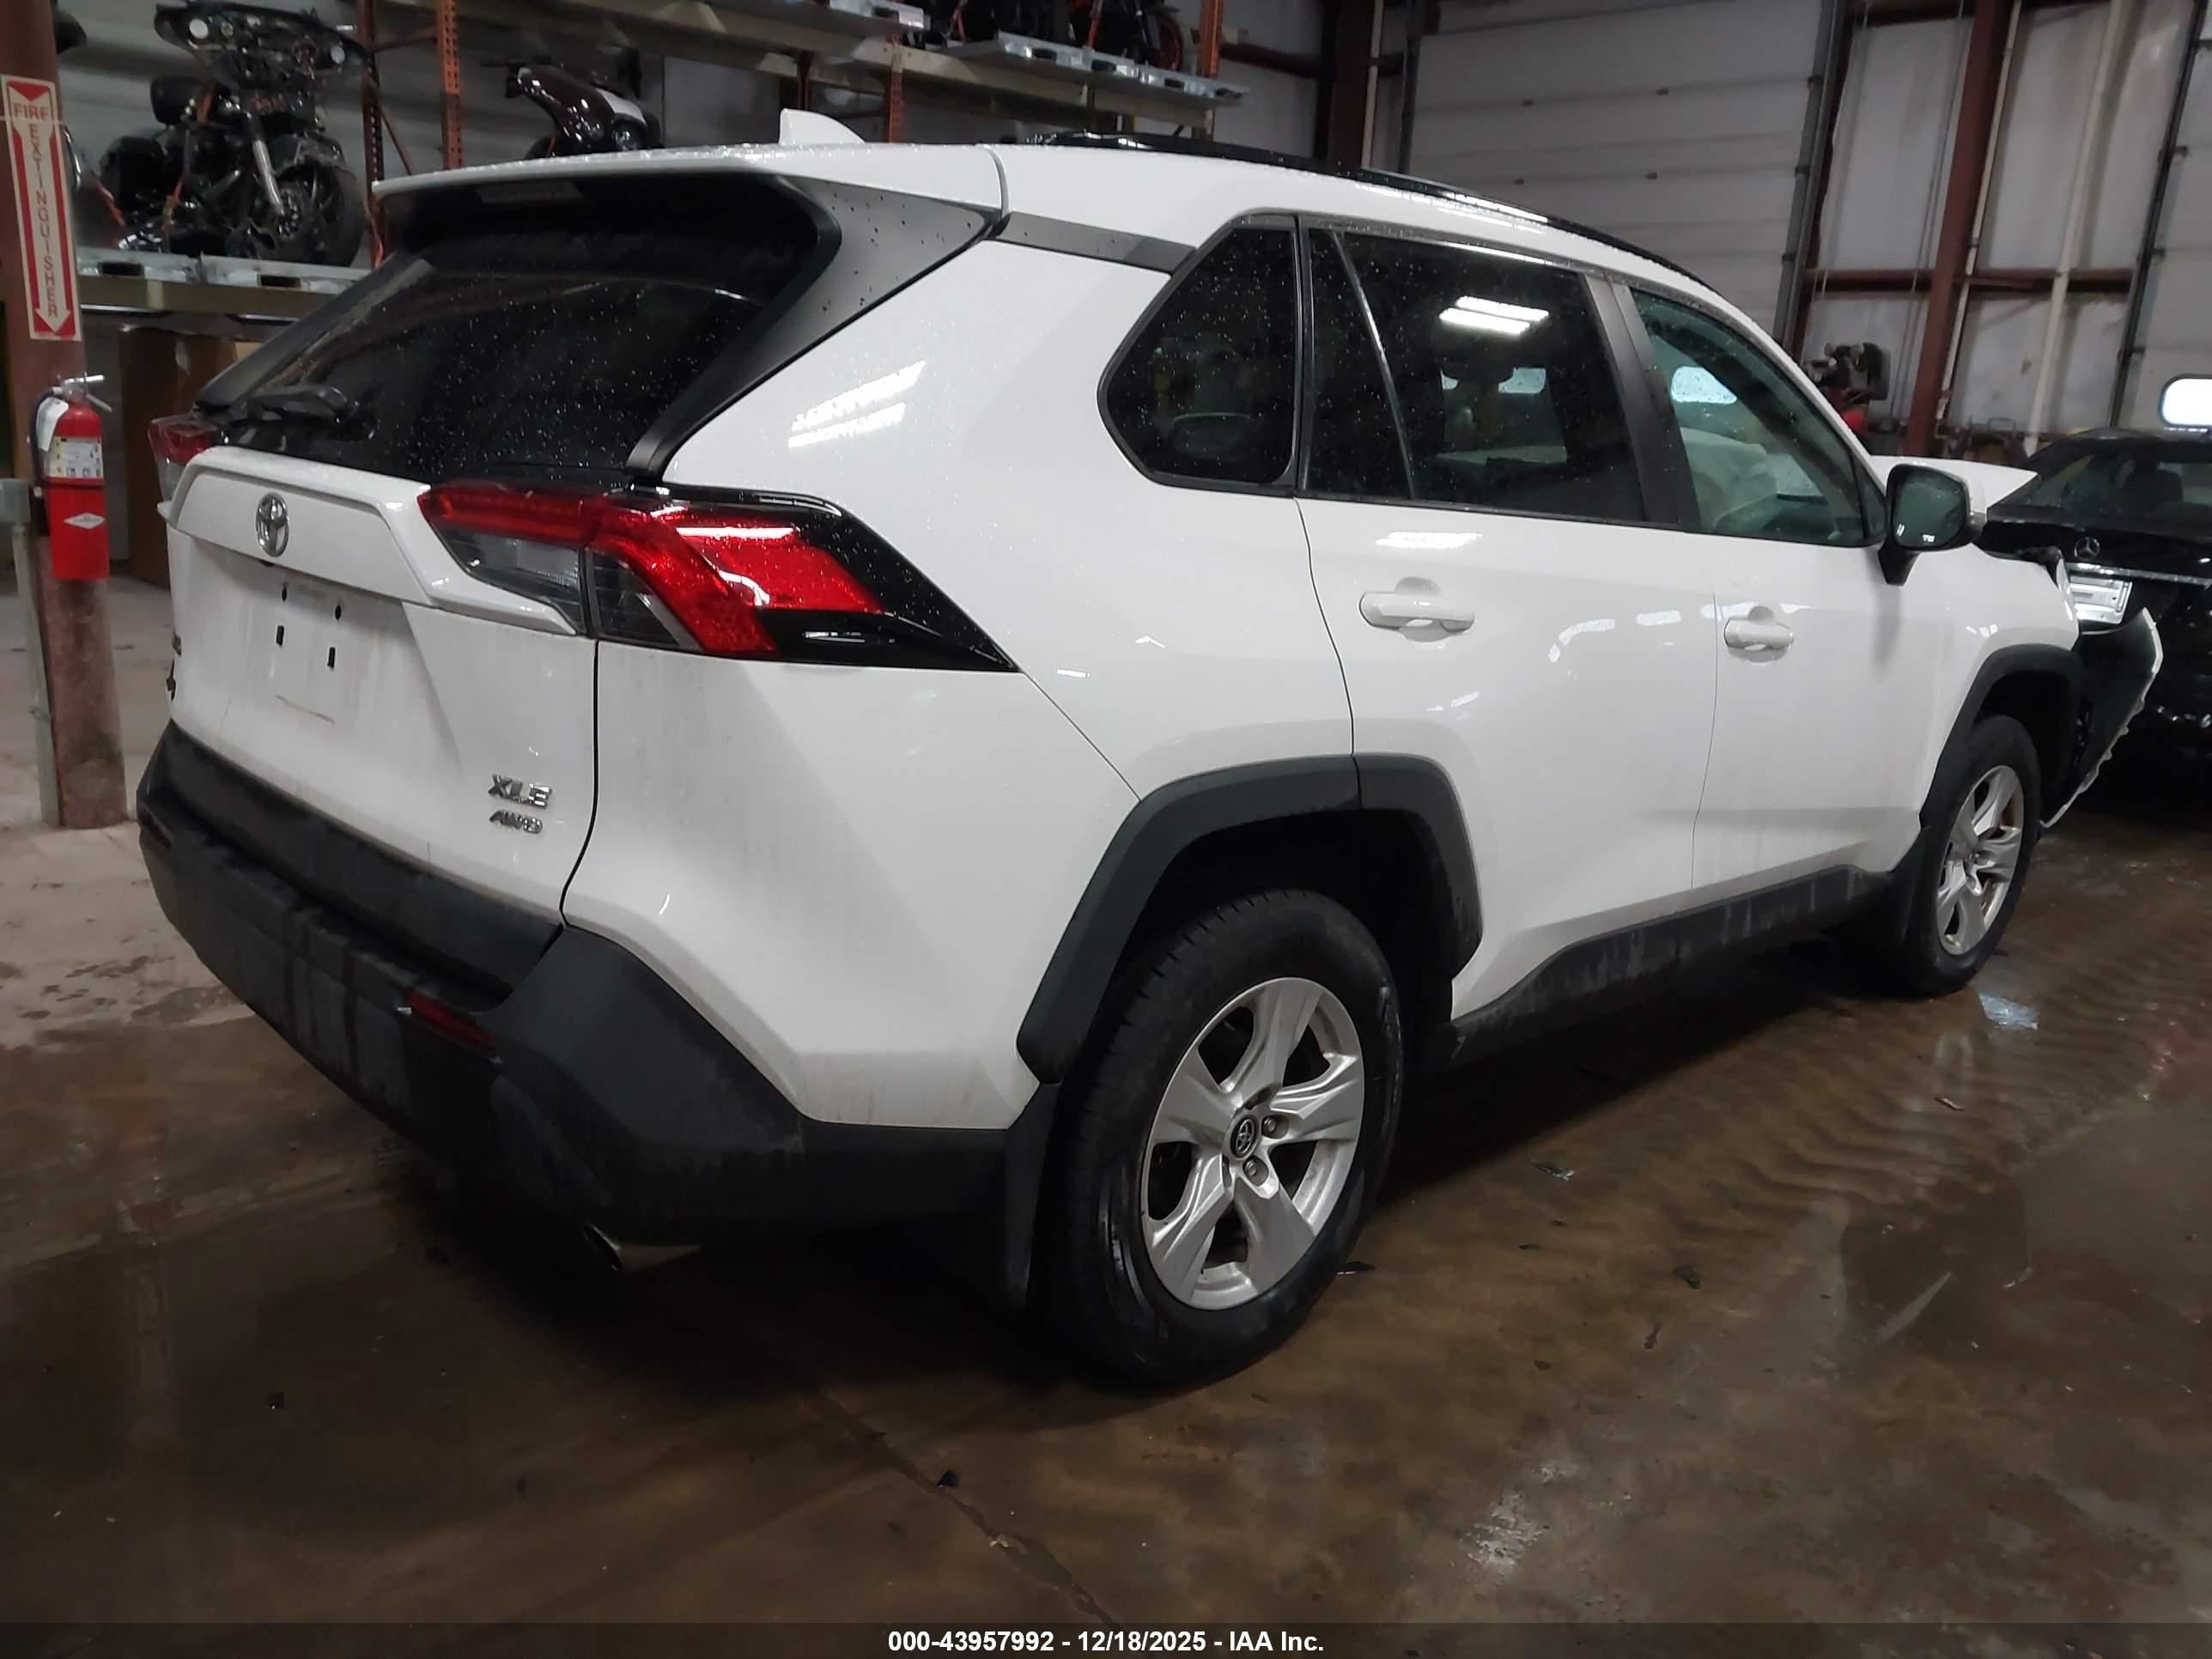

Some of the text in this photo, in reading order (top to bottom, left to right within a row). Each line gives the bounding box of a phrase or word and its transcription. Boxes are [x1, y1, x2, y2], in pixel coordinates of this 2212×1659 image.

[13, 103, 49, 120] FIRE
[28, 123, 58, 317] EXTINGUISHER
[488, 774, 551, 811] XLE
[489, 810, 543, 834] AWD
